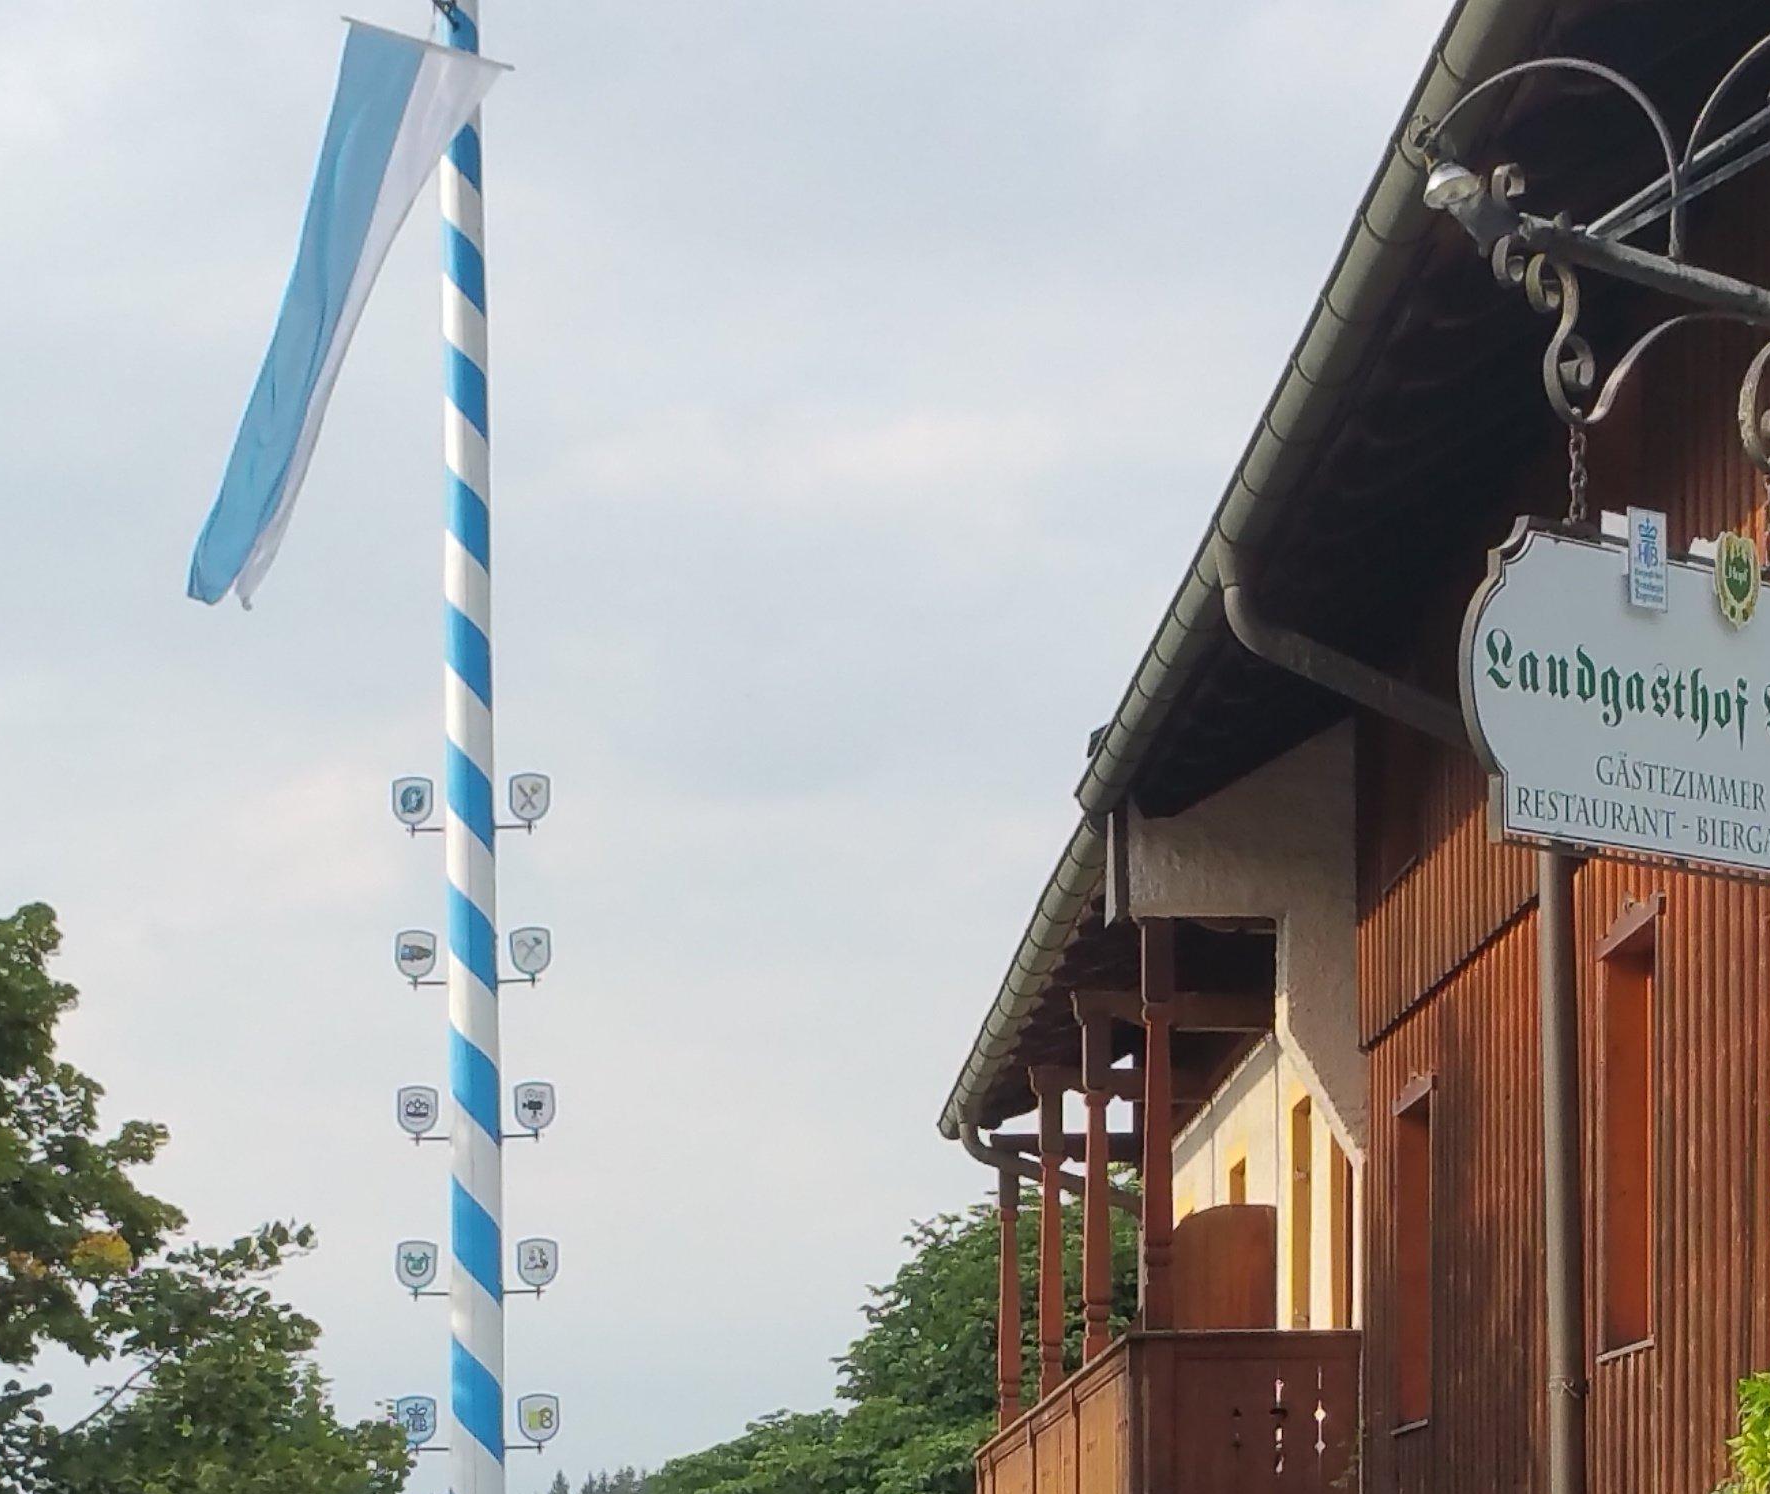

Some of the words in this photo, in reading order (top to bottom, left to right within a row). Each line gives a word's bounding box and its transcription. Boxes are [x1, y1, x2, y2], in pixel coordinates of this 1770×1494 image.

[1485, 627, 1749, 751] Landgasthof
[1595, 751, 1767, 813] GÄSTEZIMMER
[1514, 786, 1676, 841] RESTAURANT
